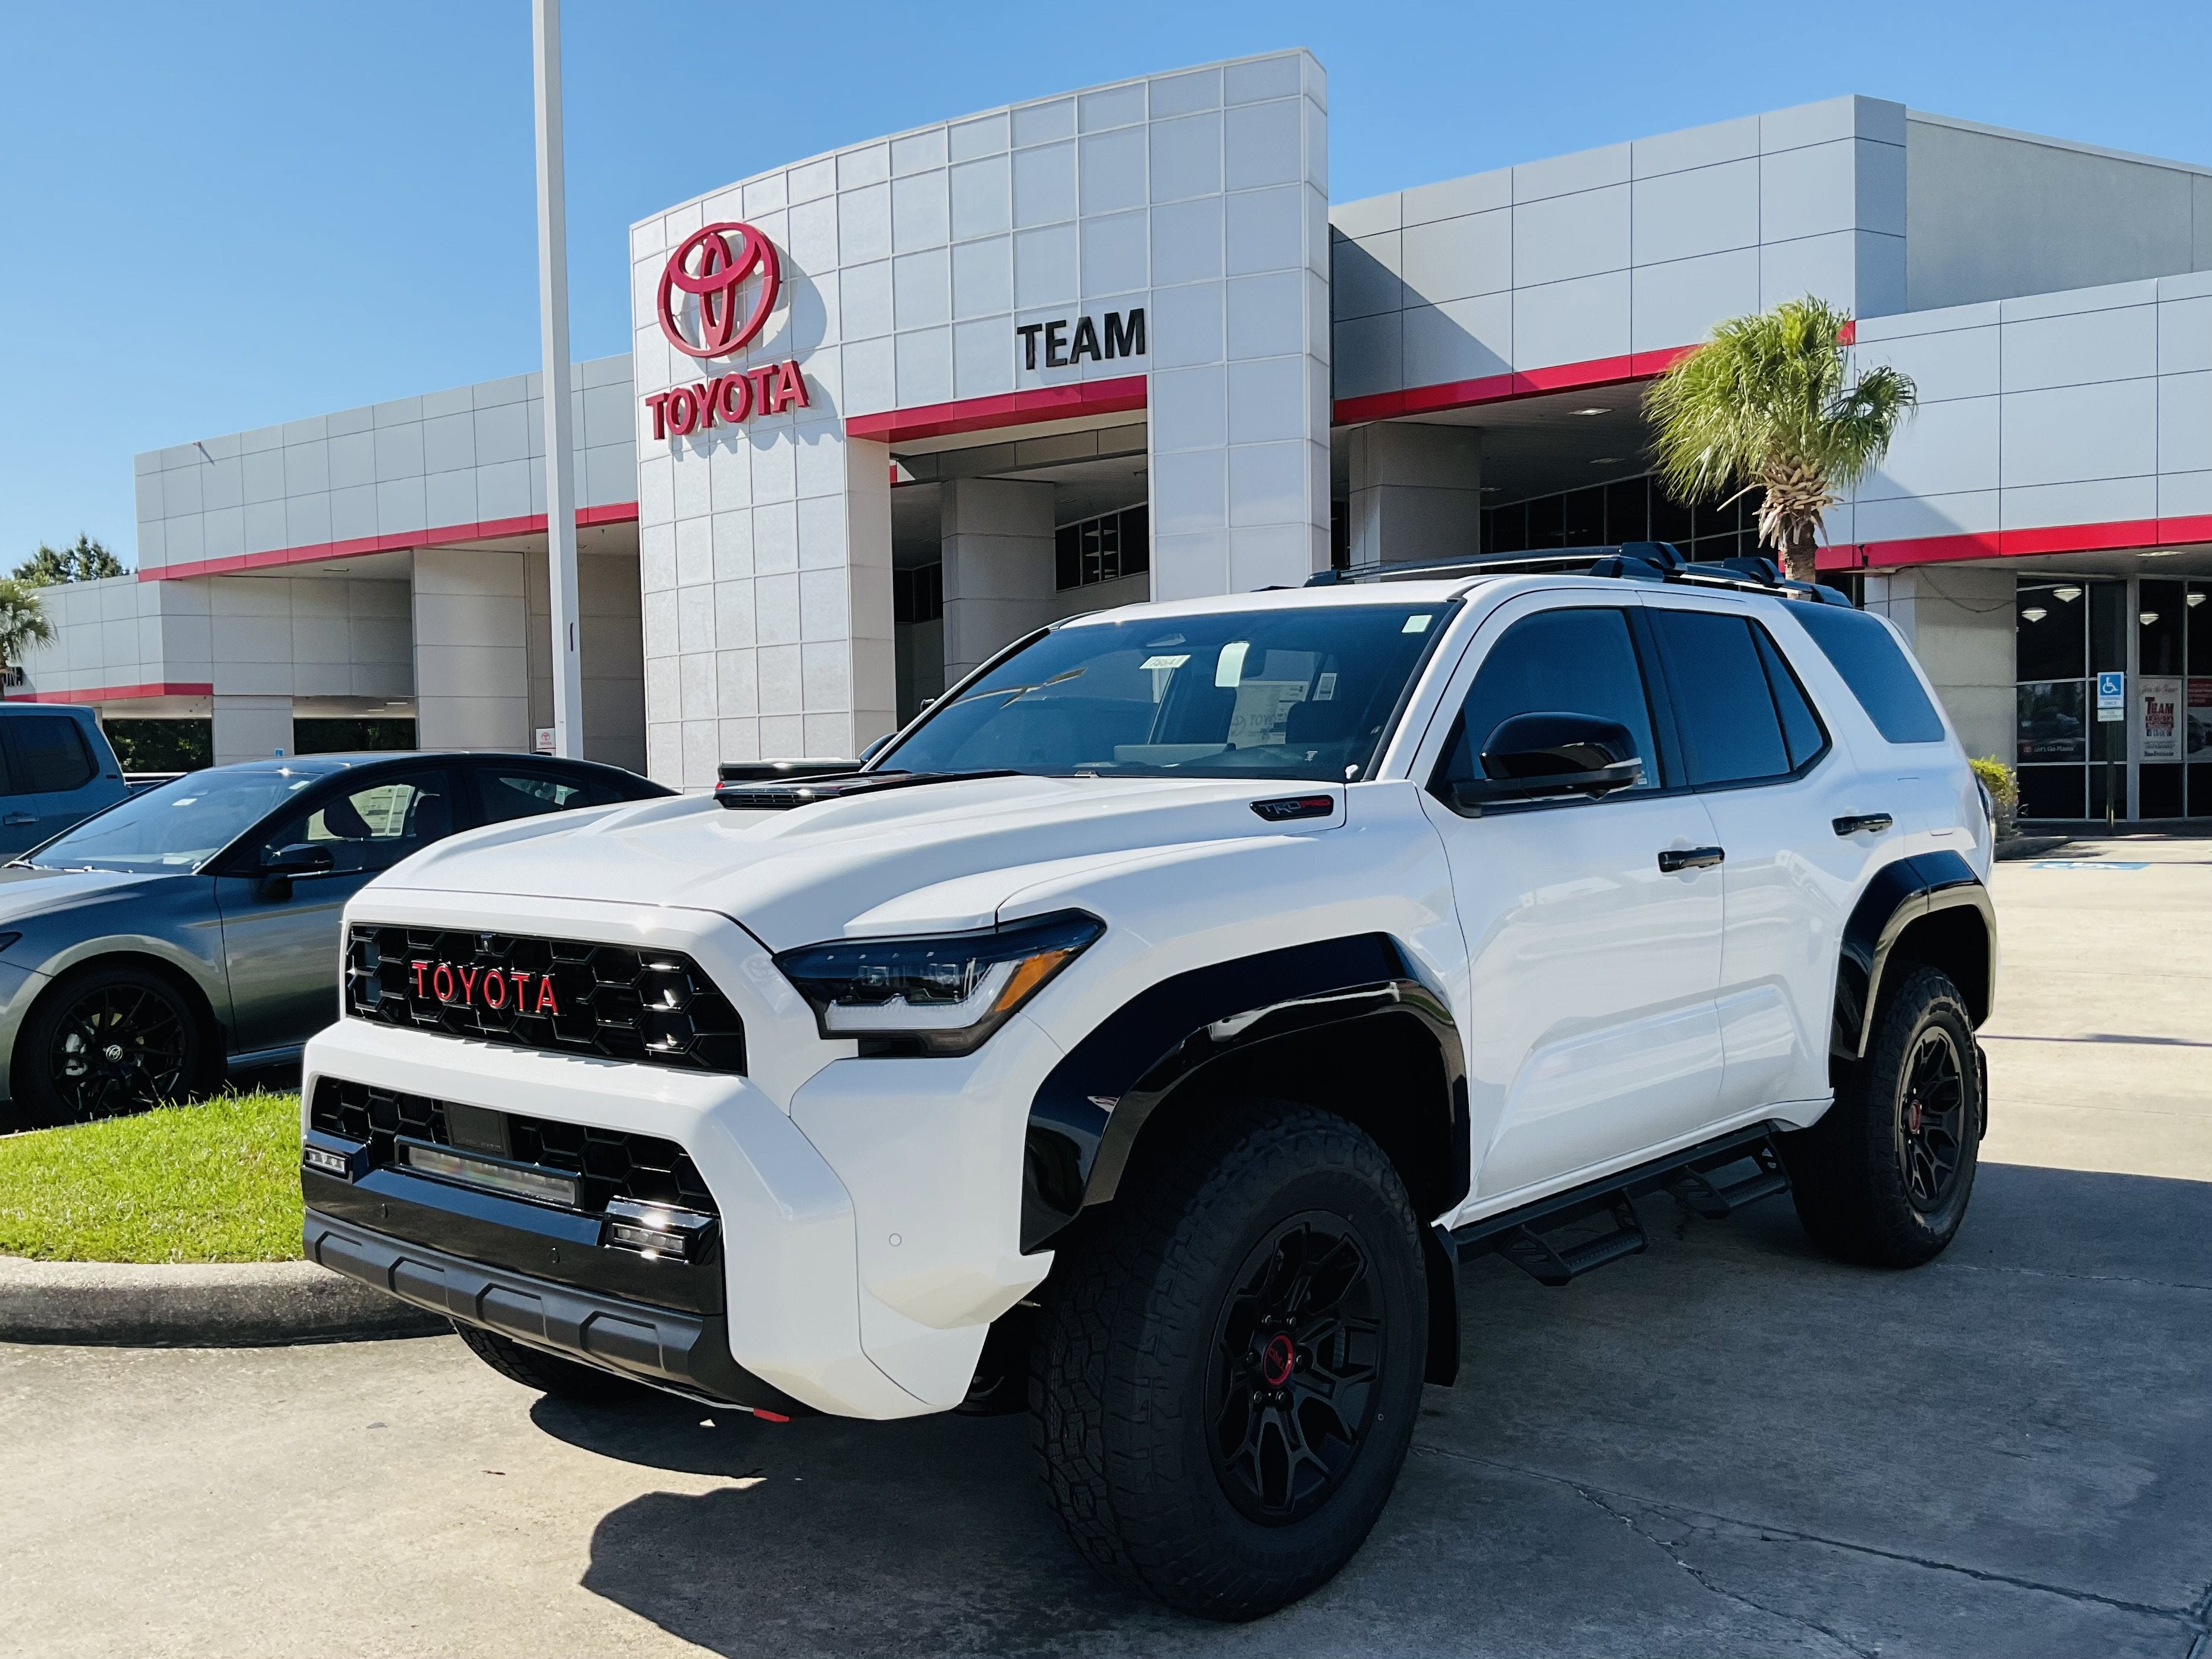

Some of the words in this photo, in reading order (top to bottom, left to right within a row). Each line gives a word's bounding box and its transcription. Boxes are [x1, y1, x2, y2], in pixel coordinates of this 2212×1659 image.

[1017, 308, 1146, 370] TEAM
[646, 360, 810, 440] TOYOTA
[1259, 801, 1301, 814] TRD
[411, 960, 559, 1016] TOYOTA
